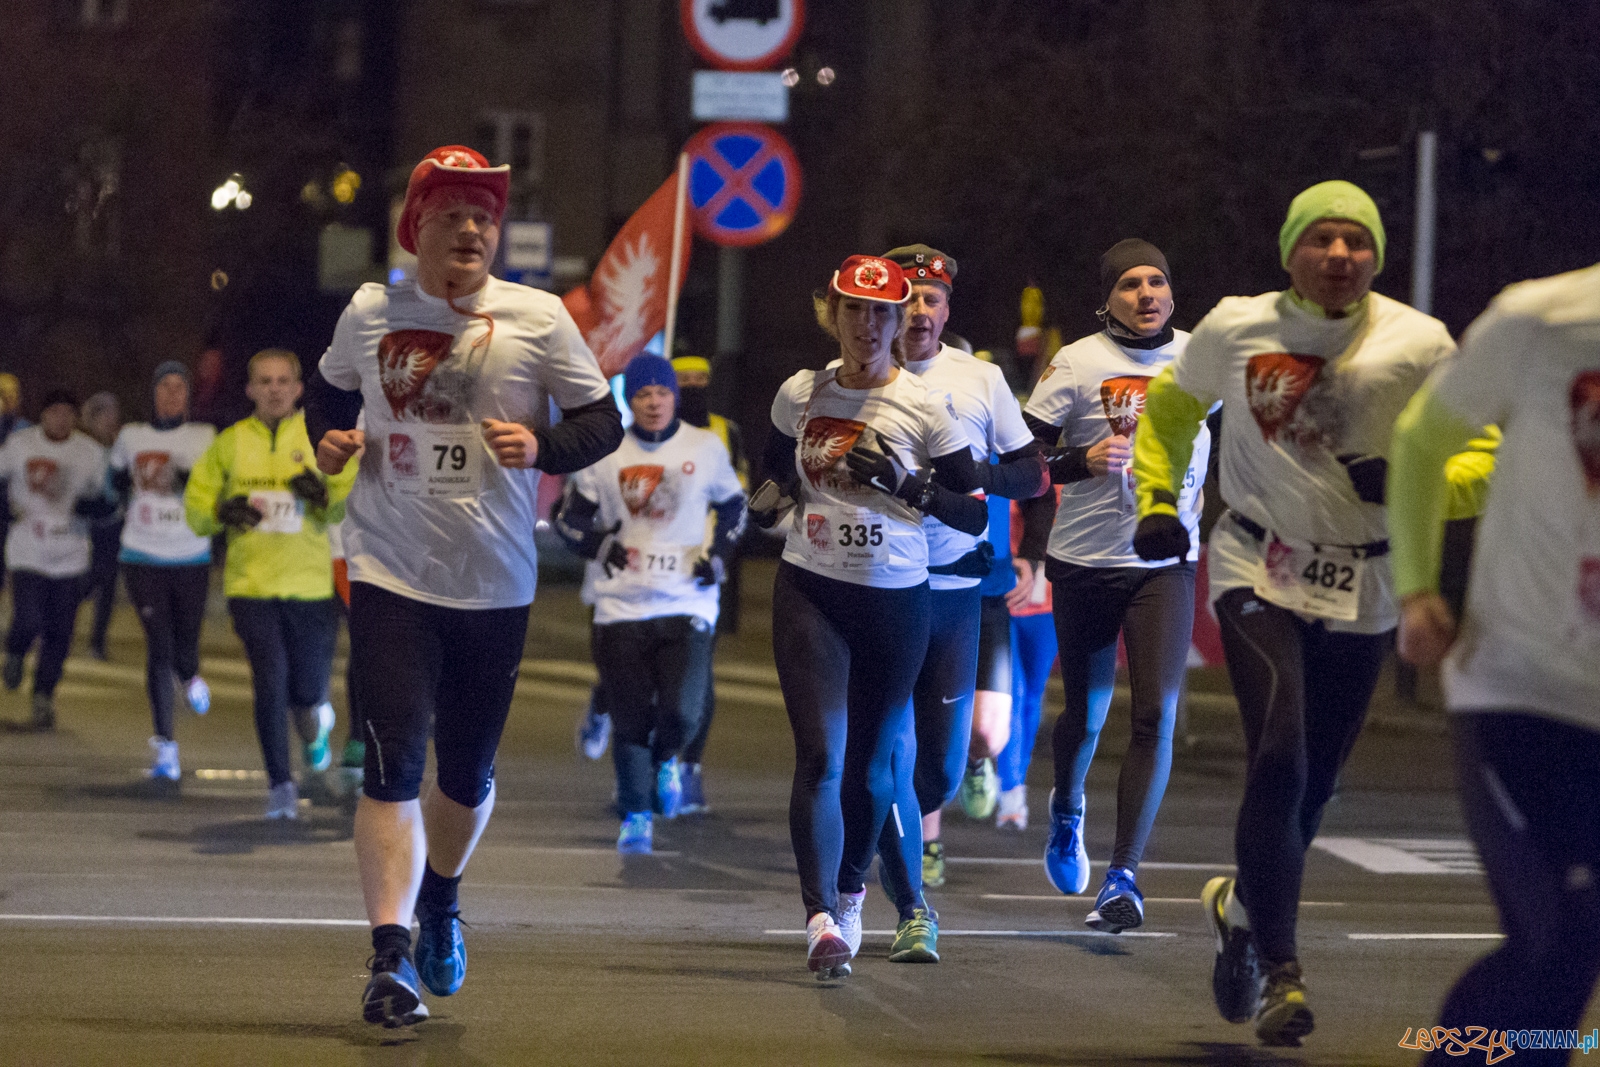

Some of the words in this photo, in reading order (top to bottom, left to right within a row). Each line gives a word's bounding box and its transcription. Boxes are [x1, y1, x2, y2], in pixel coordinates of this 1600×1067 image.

[432, 444, 466, 470] 79
[838, 523, 884, 547] 335
[646, 554, 678, 571] 712
[1302, 559, 1355, 593] 482
